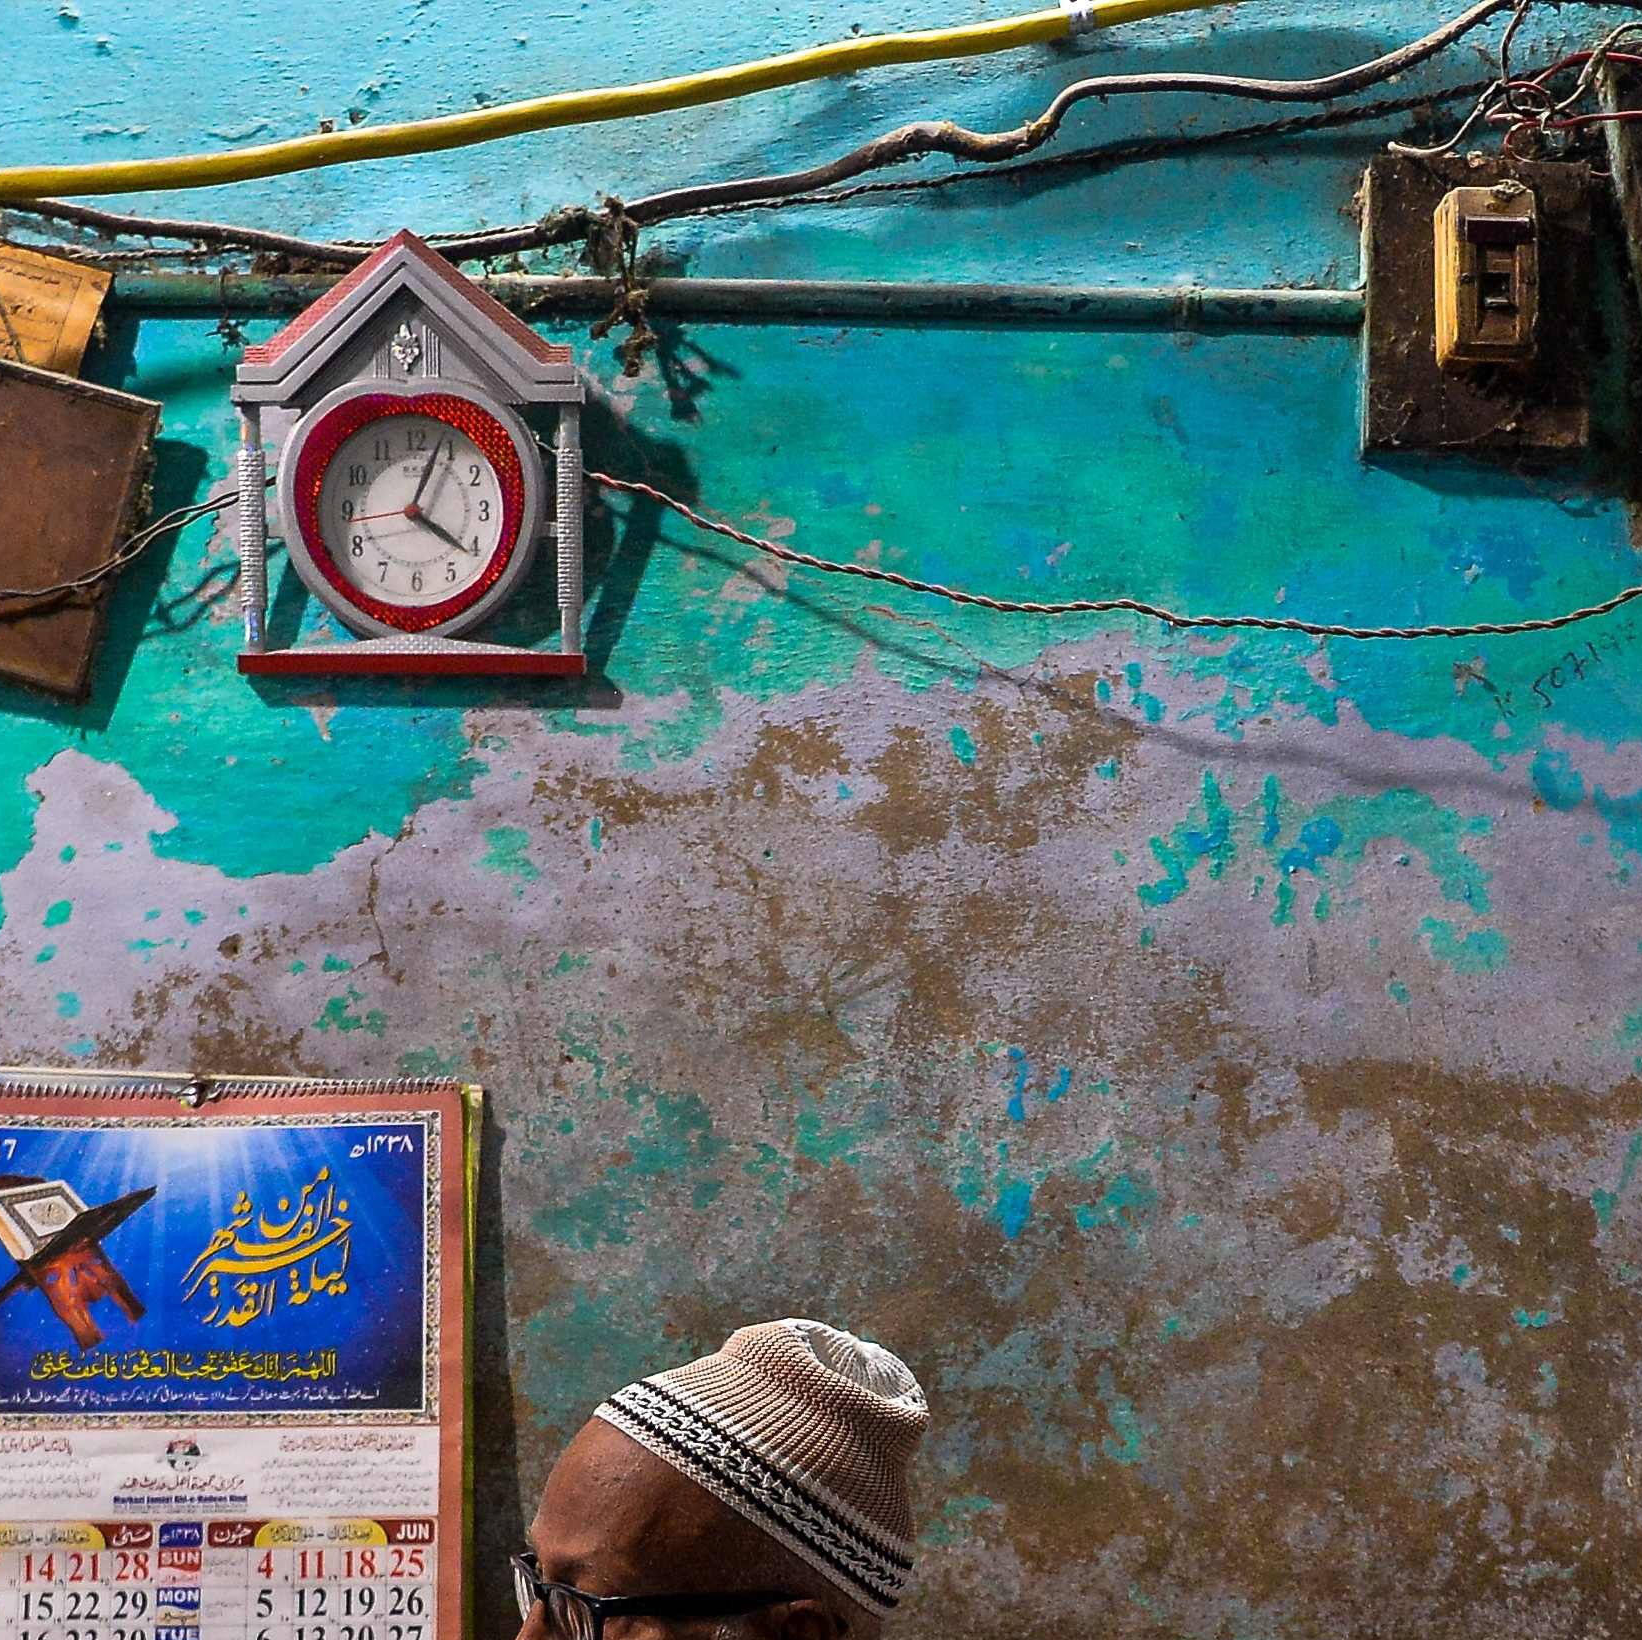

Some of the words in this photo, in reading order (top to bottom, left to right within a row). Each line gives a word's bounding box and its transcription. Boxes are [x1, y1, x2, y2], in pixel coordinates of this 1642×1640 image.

[375, 440, 390, 461] 11
[407, 431, 426, 451] 12
[447, 440, 454, 461] 1
[349, 464, 367, 486] 10
[470, 464, 480, 486] 2
[342, 500, 353, 522] 9
[479, 500, 489, 522] 3
[352, 536, 363, 557] 8
[467, 536, 479, 557] 4
[378, 562, 388, 583] 7
[412, 571, 422, 592] 6
[445, 562, 456, 582] 5
[396, 1524, 430, 1540] JUN
[24, 1554, 55, 1582] 14
[69, 1554, 99, 1582] 21
[116, 1553, 150, 1581] 28
[161, 1552, 199, 1564] SUN
[257, 1551, 274, 1579] 4
[299, 1551, 325, 1579] 11
[344, 1550, 375, 1579] 18
[390, 1550, 424, 1577] 25
[22, 1593, 53, 1621] 15
[66, 1592, 99, 1620] 22
[112, 1591, 148, 1620] 29
[159, 1591, 199, 1602] MON
[257, 1589, 273, 1618] 5
[296, 1589, 327, 1616] 12
[343, 1588, 375, 1615] 19
[389, 1587, 424, 1615] 26
[158, 1630, 198, 1640] TUE
